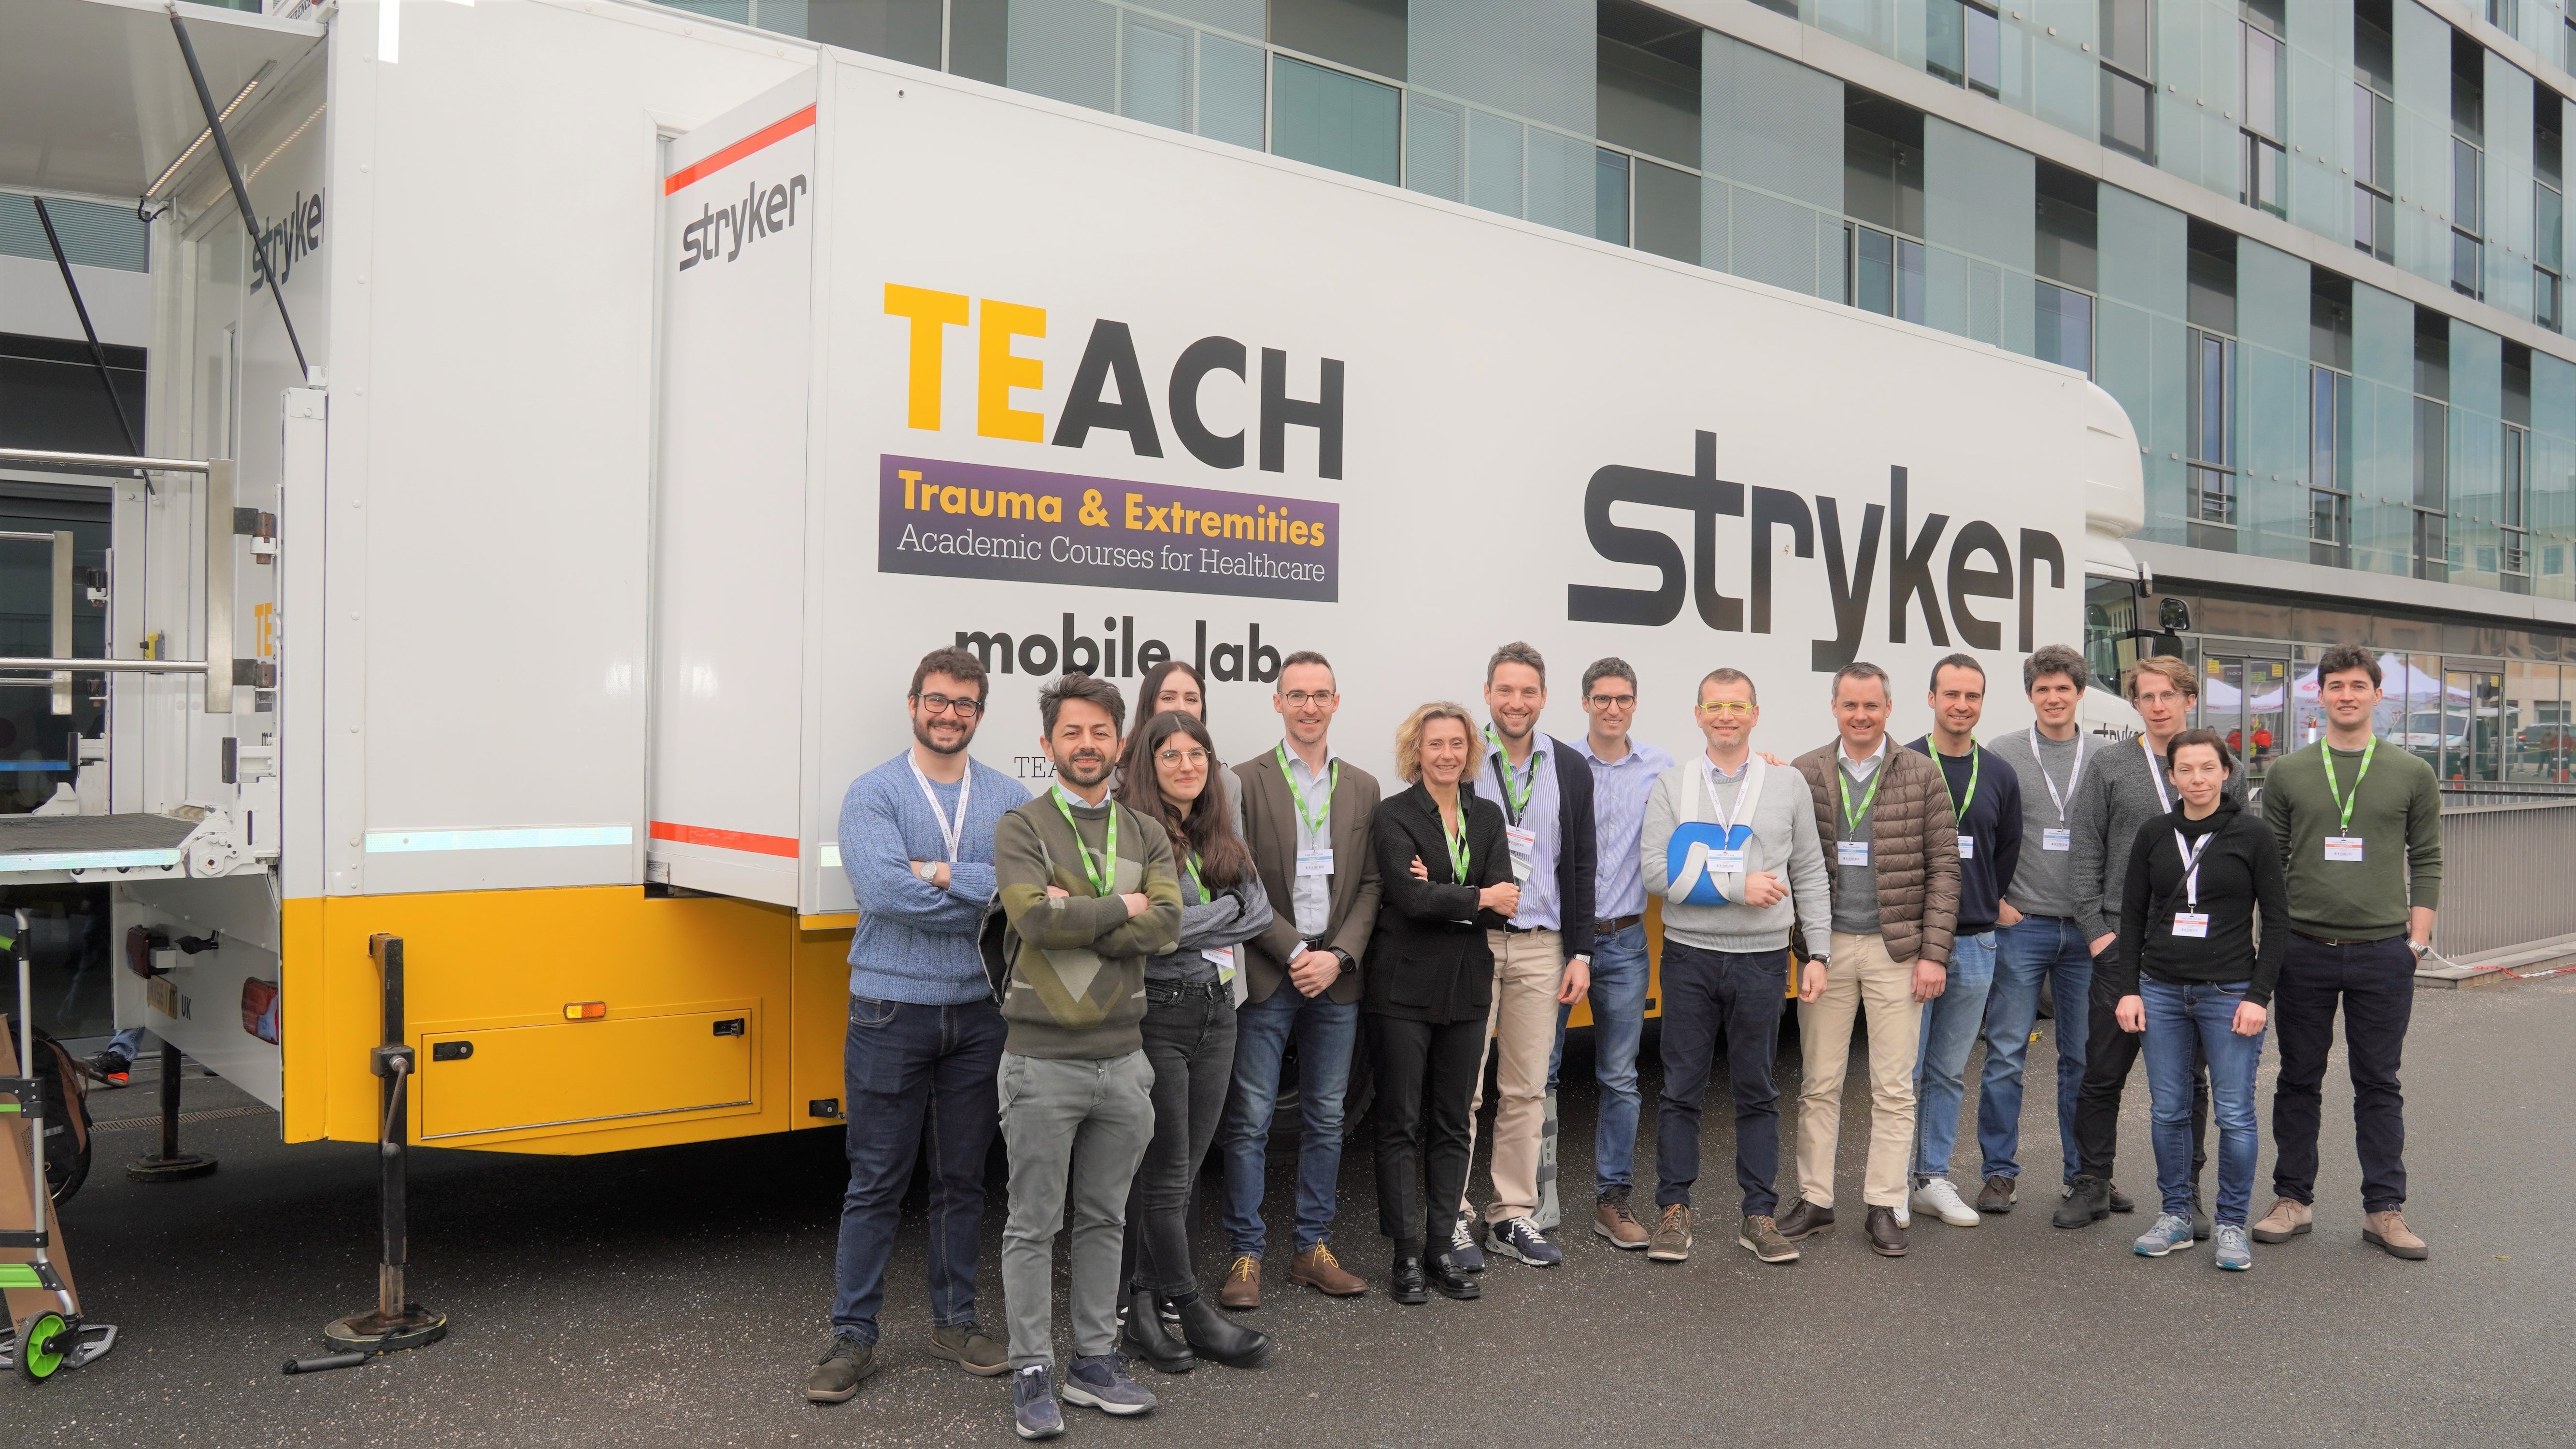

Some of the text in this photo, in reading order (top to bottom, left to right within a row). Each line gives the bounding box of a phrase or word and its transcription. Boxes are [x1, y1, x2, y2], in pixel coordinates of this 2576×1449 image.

[250, 186, 325, 296] stryke
[680, 174, 807, 271] stryker
[884, 283, 1344, 480] TEACH
[898, 469, 1325, 547] Trauma & Extremities
[897, 523, 1325, 582] Academic Courses for Healthcare
[1568, 429, 2065, 672] stryker
[955, 612, 1281, 683] mobile lab
[944, 829, 953, 850] WALDNER
[182, 994, 191, 1020] UK
